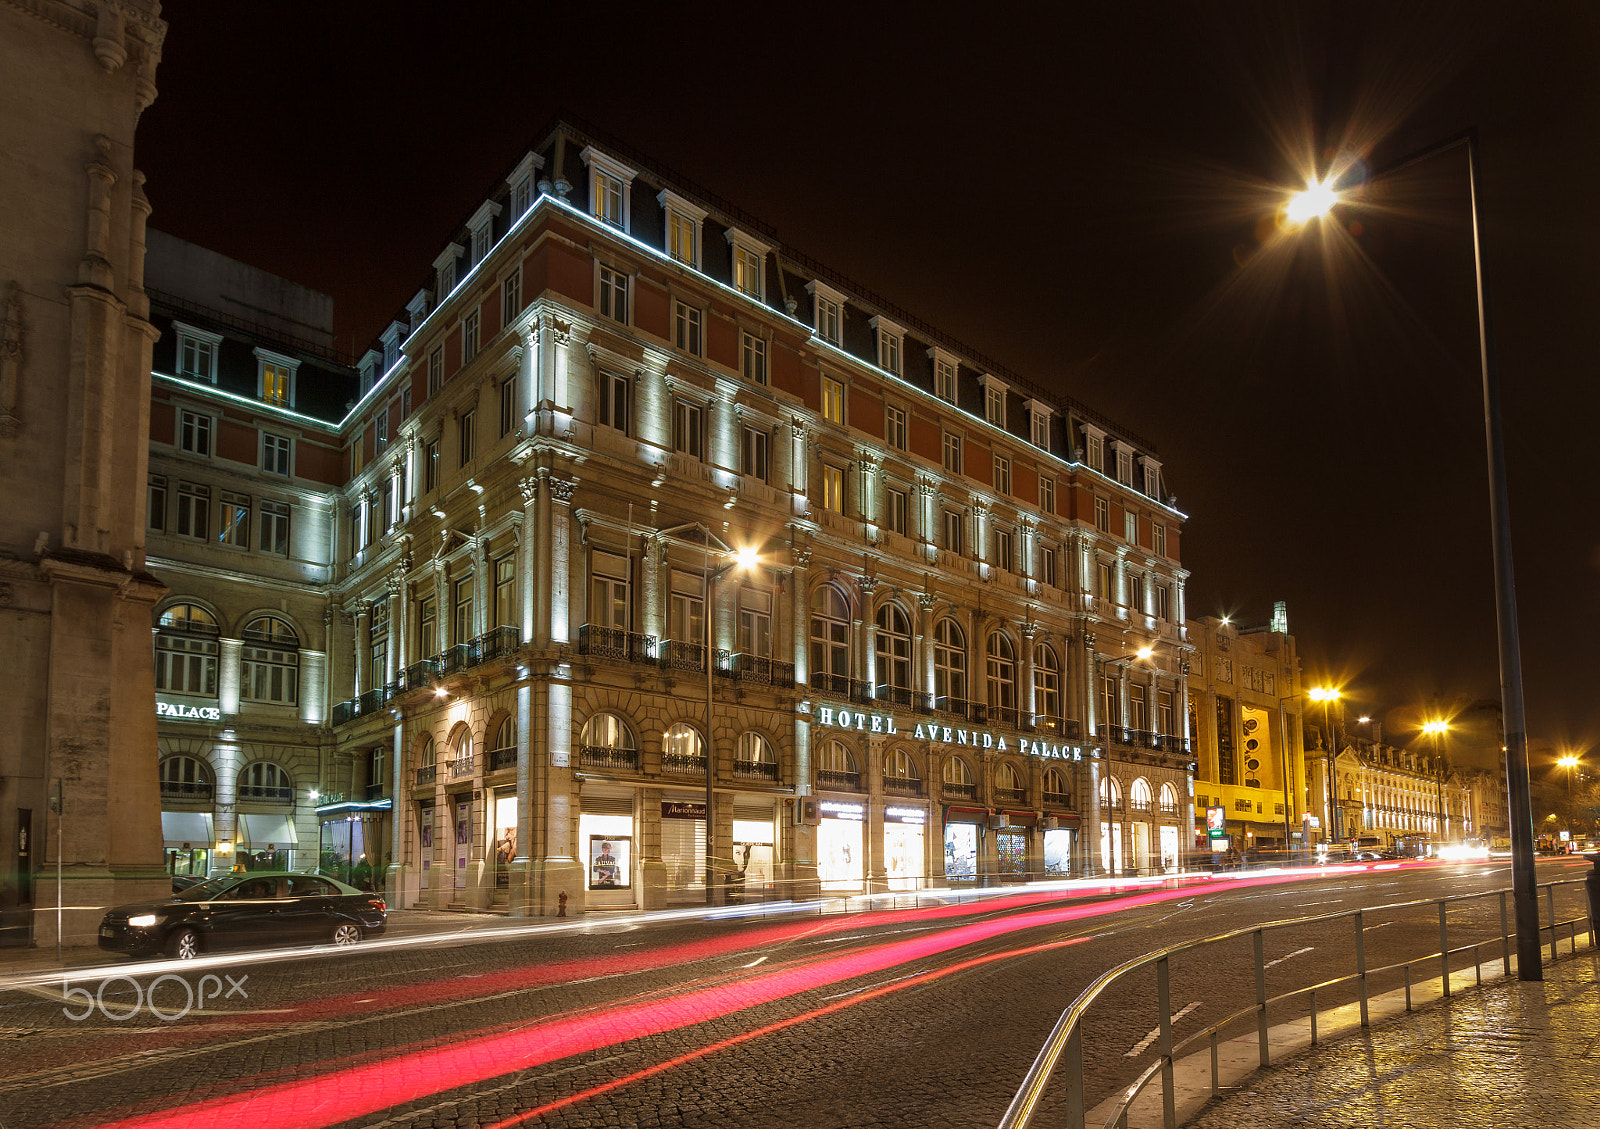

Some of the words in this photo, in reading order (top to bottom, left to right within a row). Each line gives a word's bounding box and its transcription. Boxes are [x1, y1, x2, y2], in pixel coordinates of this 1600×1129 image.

[156, 702, 220, 720] PALACE
[820, 707, 897, 735] HOTEL
[914, 723, 1007, 750] AVENIDA
[1020, 739, 1081, 760] PALACE
[667, 804, 706, 815] Marionnaud
